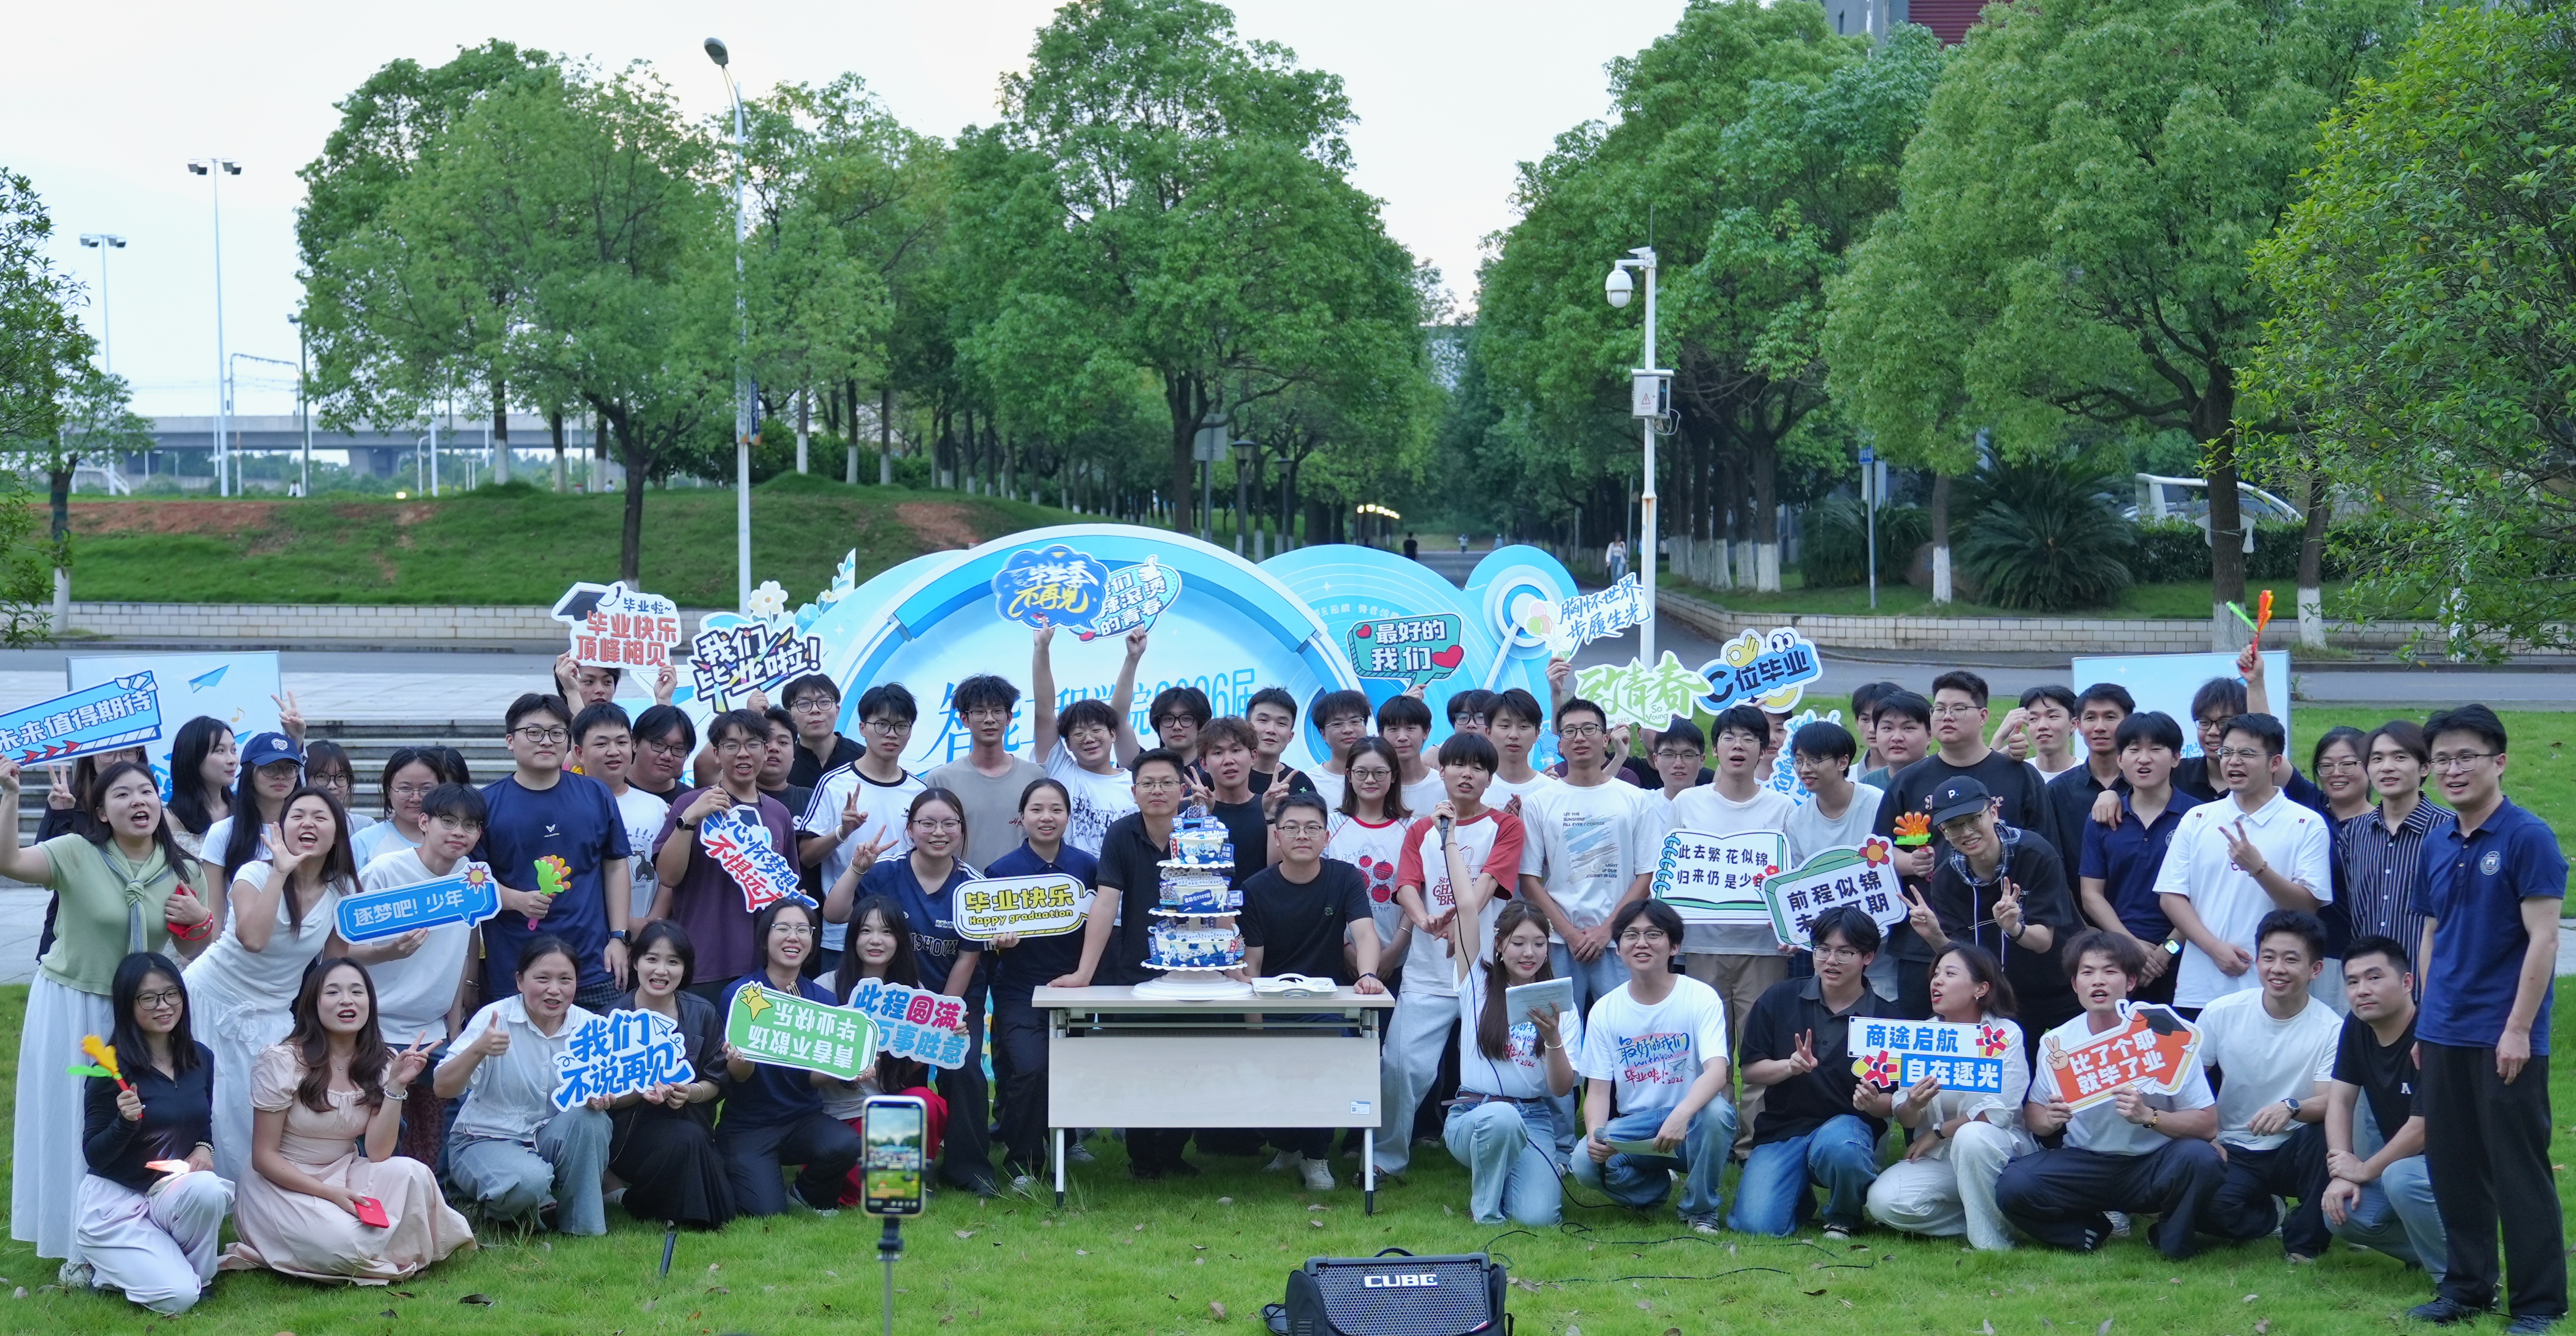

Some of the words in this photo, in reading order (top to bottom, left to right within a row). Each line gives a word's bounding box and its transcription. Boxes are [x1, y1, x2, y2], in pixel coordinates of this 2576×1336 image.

[1100, 598, 1163, 636] 的青春
[1558, 574, 1644, 625] 胸怀世界
[587, 610, 677, 643] 毕业快乐
[1376, 619, 1447, 645] 最好的
[1566, 603, 1651, 656] 步履生光
[576, 634, 667, 667] 顶峰相见
[695, 627, 768, 667] 我们
[1371, 646, 1432, 672] 我们
[1577, 653, 1711, 728] 致青春
[1707, 650, 1810, 703] C位毕业
[0, 689, 152, 752] 未来值得期待
[1645, 713, 1669, 722] Young
[1651, 704, 1663, 713] So
[965, 884, 1075, 914] 毕业快乐
[1787, 870, 1882, 913] 前程似锦
[969, 915, 1007, 927] Happy
[1009, 909, 1073, 924] graduation
[773, 1001, 858, 1043] 毕业快乐
[854, 984, 961, 1032] 此程圆满
[570, 1012, 650, 1062] 我们
[747, 1025, 854, 1069] 青春不散场
[1866, 1024, 1958, 1053] 商途启航
[2069, 1028, 2157, 1076] 比了个耶
[555, 1041, 692, 1108] 不说再见
[1520, 1059, 1536, 1068] 2026
[1906, 1058, 1999, 1088] 自在逐光
[2076, 1050, 2166, 1096] 就毕了业
[2400, 1082, 2412, 1095] A
[1364, 1274, 1438, 1287] CUBE
